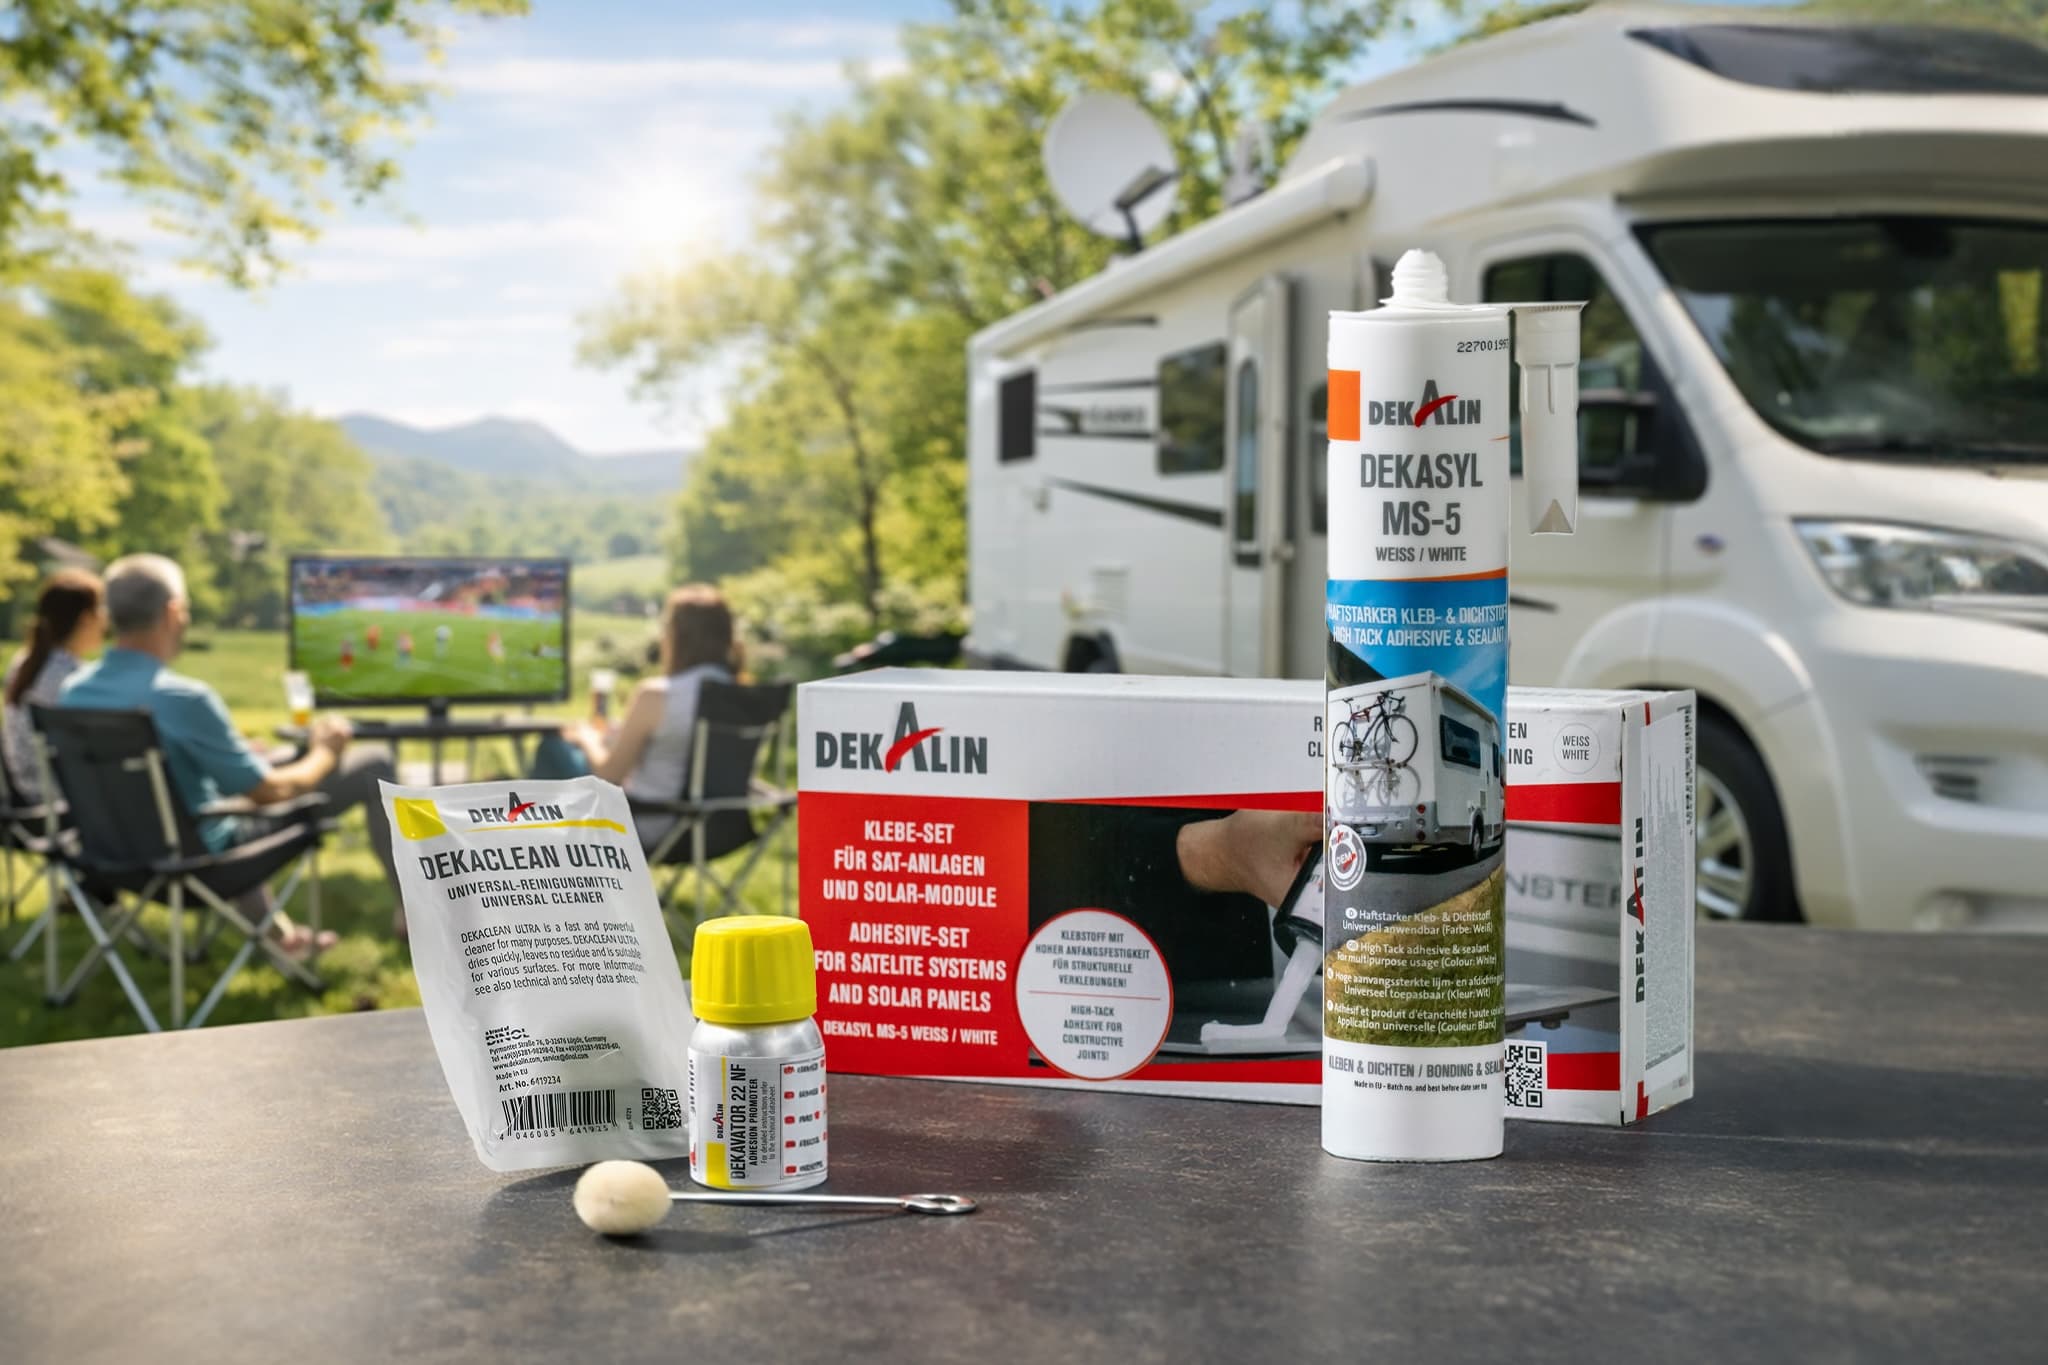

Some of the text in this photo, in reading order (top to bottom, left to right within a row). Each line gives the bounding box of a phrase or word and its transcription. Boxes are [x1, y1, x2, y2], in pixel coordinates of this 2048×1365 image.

[1368, 380, 1481, 428] DEKALIN
[1360, 454, 1482, 488] DEKASYL
[1382, 500, 1461, 536] MS-5
[1375, 546, 1467, 562] WEISS WHITE
[1401, 608, 1441, 624] KLEB-
[1446, 608, 1456, 624] &
[1333, 626, 1505, 647] HIGH TACK ADHESIVE & SEALANT
[815, 701, 988, 774] DEKALIN
[1562, 736, 1590, 747] WEISS
[1562, 749, 1590, 760] WHITE
[468, 791, 564, 823] DEKALIN
[864, 820, 954, 844] KLEBE-SET
[419, 844, 632, 880] DEKACLEAN ULTRA
[834, 845, 985, 876] FÜR SAT-ANLAGEN
[447, 876, 624, 900] UNIVERSAL-REINIGUNGMITTEL
[823, 880, 997, 908] UND SOLAR-MODULE
[481, 891, 604, 908] UNIVERSAL CLEANER
[1359, 909, 1411, 921] Haftstarker
[1414, 912, 1440, 922] Kleb-
[460, 925, 511, 943] DEKACLEAN
[515, 924, 541, 934] ULTRA
[555, 924, 561, 932] a
[564, 921, 581, 932] fast
[584, 920, 600, 931] and
[849, 922, 969, 948] ADHESIVE-SET
[1061, 930, 1124, 943] KLEBSTOFF MIT
[1343, 920, 1381, 933] Universell
[1384, 924, 1440, 935] anwendbar
[1442, 924, 1472, 936] (Farbe:
[464, 942, 496, 956] cleaner
[497, 939, 509, 949] for
[511, 939, 532, 949] many
[534, 936, 572, 948] purposes.
[573, 934, 617, 944] DEKACLEAN
[1036, 944, 1150, 960] HOHER ANFANGSFESTIGKEIT
[1360, 942, 1489, 955] High Tack adhesive sealant
[468, 947, 606, 970] dries quickly, leaves no residue and
[814, 950, 1007, 981] FOR SATELITE SYSTEMS
[1053, 958, 1132, 974] FÜR STRUKTURELLE
[1348, 953, 1407, 968] multipurpose
[1410, 959, 1439, 970] usage
[1441, 956, 1474, 968] (Colour:
[472, 962, 600, 982] for various surfaces. For more
[474, 985, 491, 996] see
[493, 981, 511, 992] also
[513, 976, 550, 988] technical
[552, 974, 568, 985] and
[569, 974, 594, 986] safety
[596, 974, 614, 984] data
[1059, 974, 1127, 988] VERKLEBUNGEN!
[1354, 975, 1430, 989] aanvangssterkte
[1456, 979, 1467, 987] en
[829, 983, 991, 1012] AND SOLAR PANELS
[1344, 984, 1387, 998] Universeel
[1390, 990, 1445, 1001] toepasbaar
[1447, 989, 1475, 1000] (Kleur:
[1071, 1005, 1114, 1016] HIGH-TACK
[1360, 1008, 1369, 1016] et
[1372, 1008, 1406, 1019] produit
[1469, 1008, 1489, 1018] haute
[823, 1020, 998, 1045] DEKASYL MS-5 WEISS WHITE
[1064, 1019, 1122, 1032] ADHESIVE FOR
[1337, 1016, 1380, 1029] Application
[1382, 1022, 1436, 1032] universelle
[1438, 1021, 1476, 1034] (Couleur:
[1062, 1034, 1124, 1047] CONSTRUCTIVE
[1077, 1050, 1110, 1061] JOINTS!
[496, 1072, 512, 1081] Made
[1368, 1061, 1414, 1077] DICHTEN
[1426, 1063, 1474, 1078] BONDING
[499, 1076, 561, 1093] Art. No. 6419234
[1387, 1083, 1403, 1091] Batch
[1416, 1084, 1426, 1092] and
[1428, 1084, 1440, 1092] best
[1441, 1084, 1459, 1092] before
[730, 1064, 746, 1179] DEKAVATOR 22 NF
[749, 1079, 758, 1166] ADHESION PROMOTER
